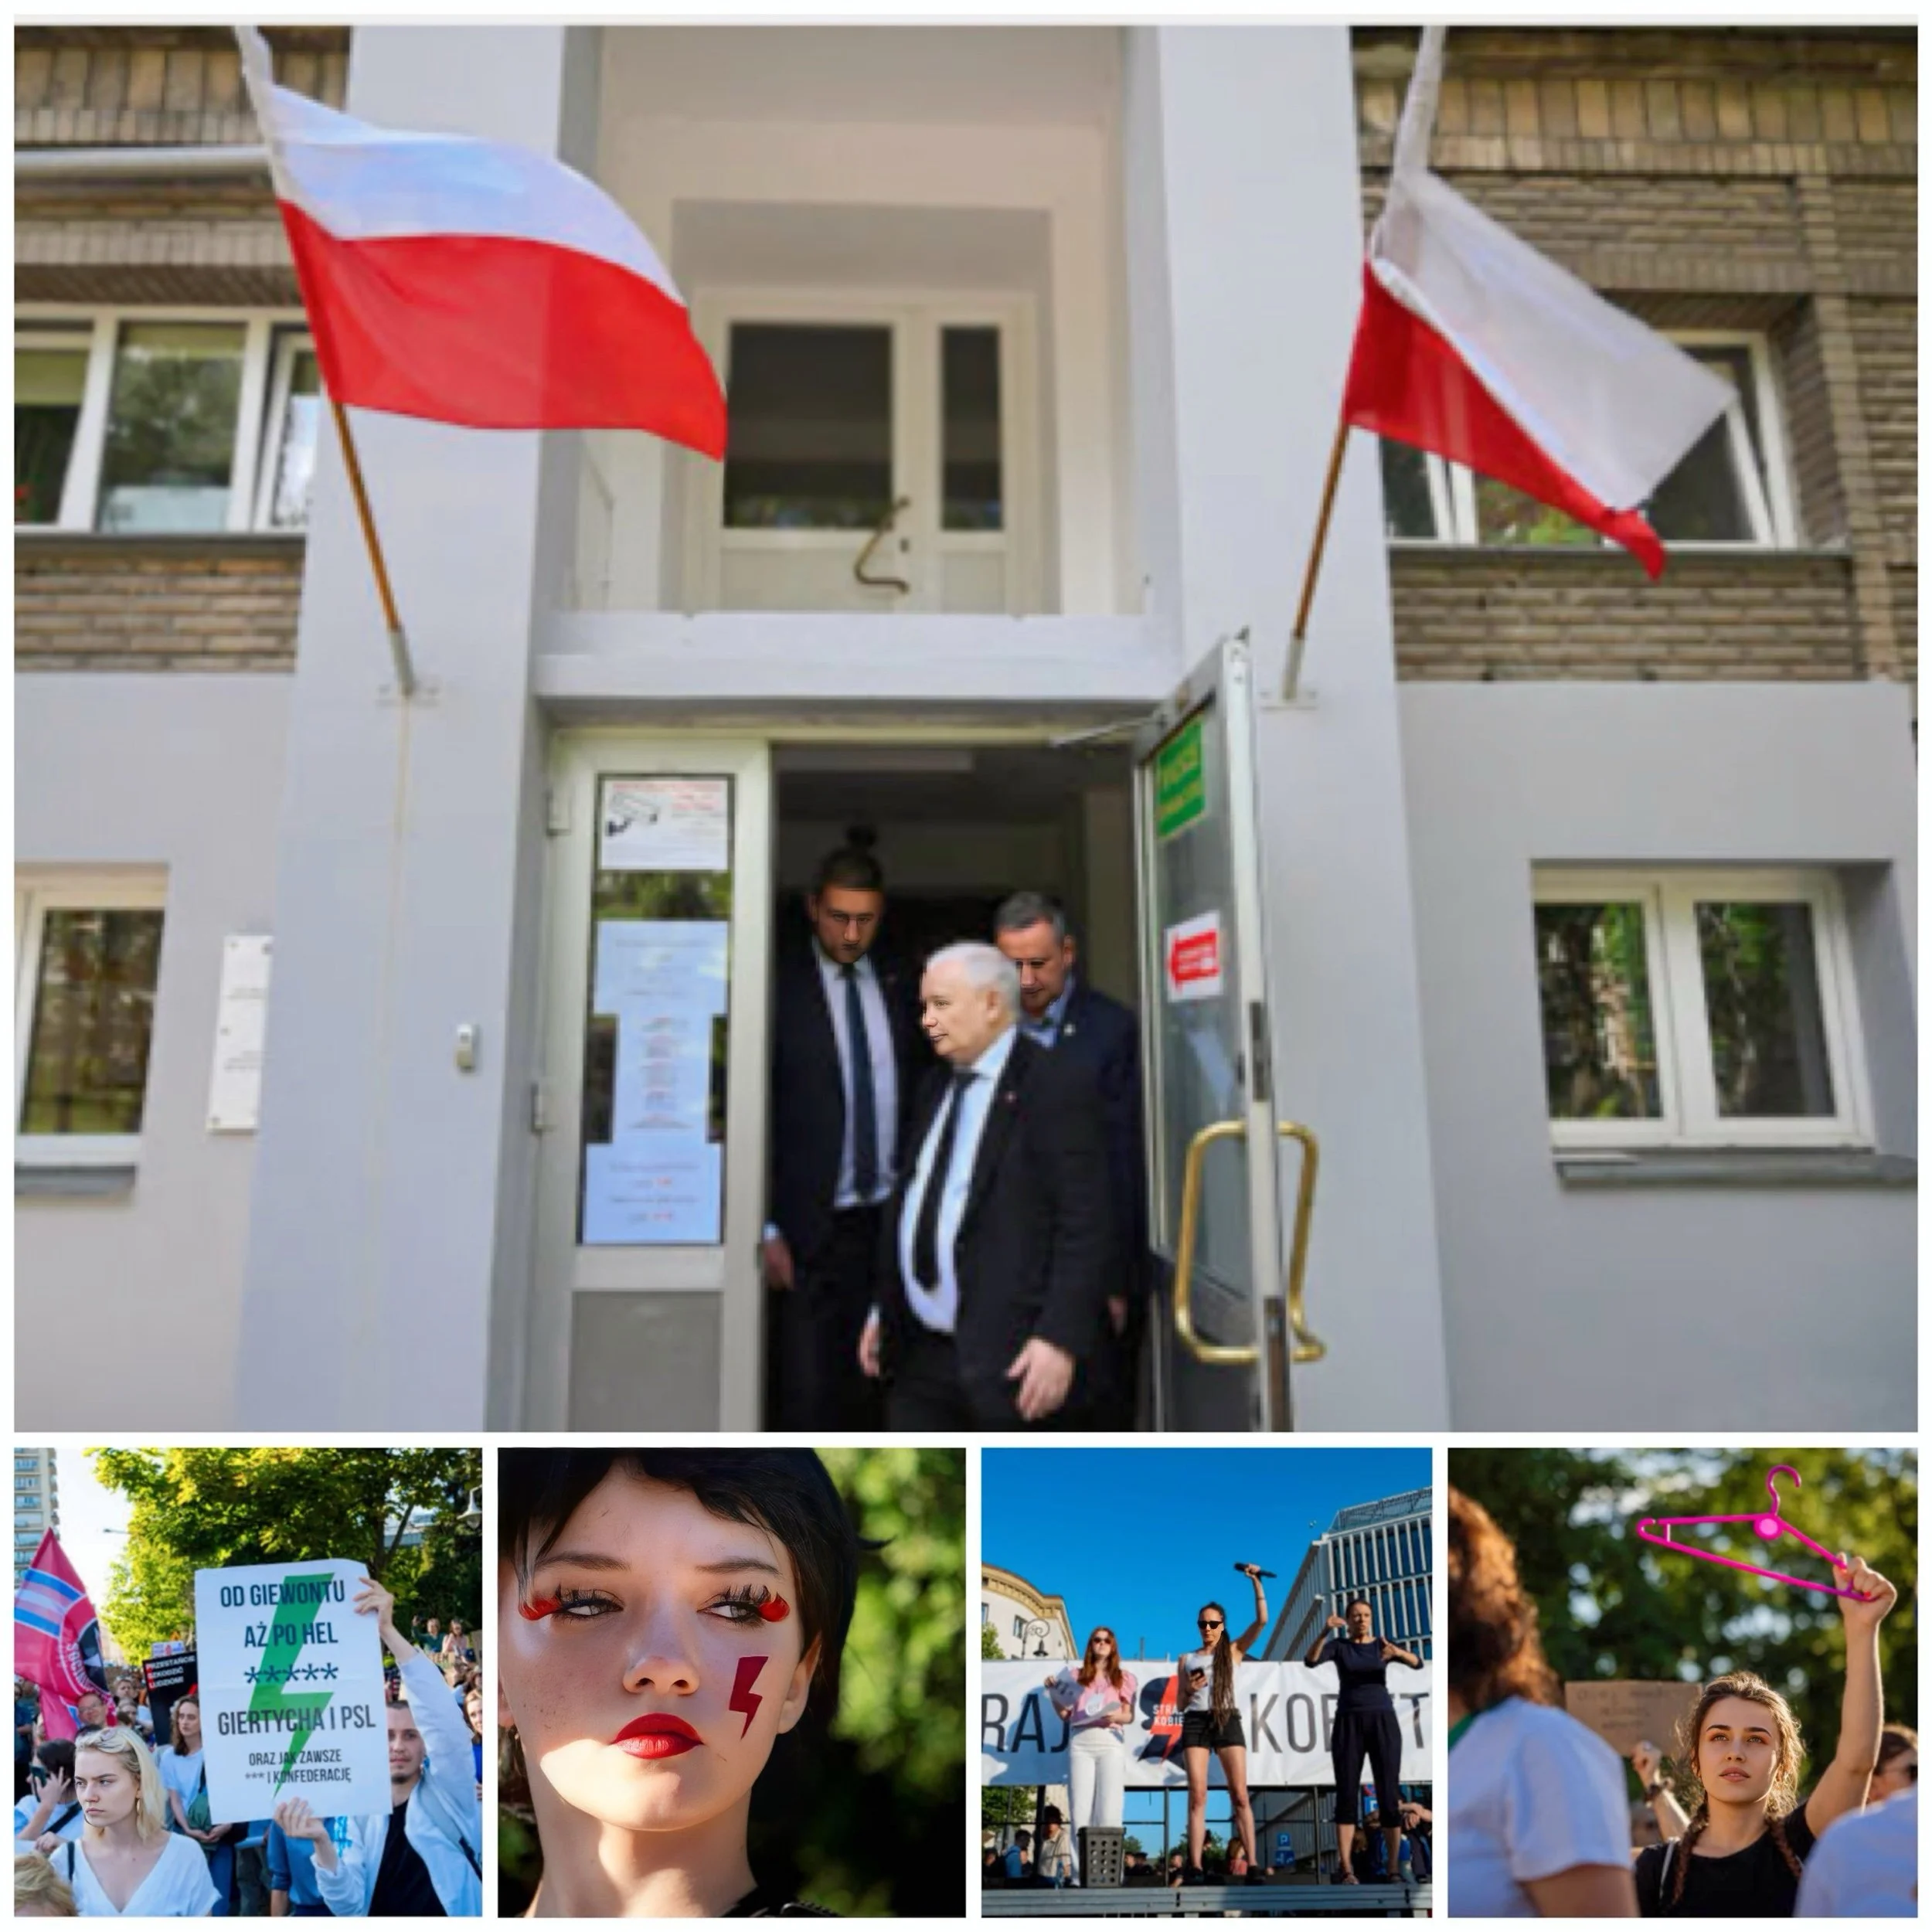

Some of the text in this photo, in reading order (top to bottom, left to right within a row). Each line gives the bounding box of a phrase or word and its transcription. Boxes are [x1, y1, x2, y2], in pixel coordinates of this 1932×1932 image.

[220, 1580, 345, 1607] OD GIEWONTU
[244, 1621, 338, 1648] AŻ PO HEL
[218, 1704, 376, 1736] GIERTYCHA I PSL
[1152, 1703, 1183, 1715] STRA
[249, 1749, 342, 1766] ORAZ JAK ZAWSZE
[273, 1767, 352, 1784] KONFEDERACJĘ
